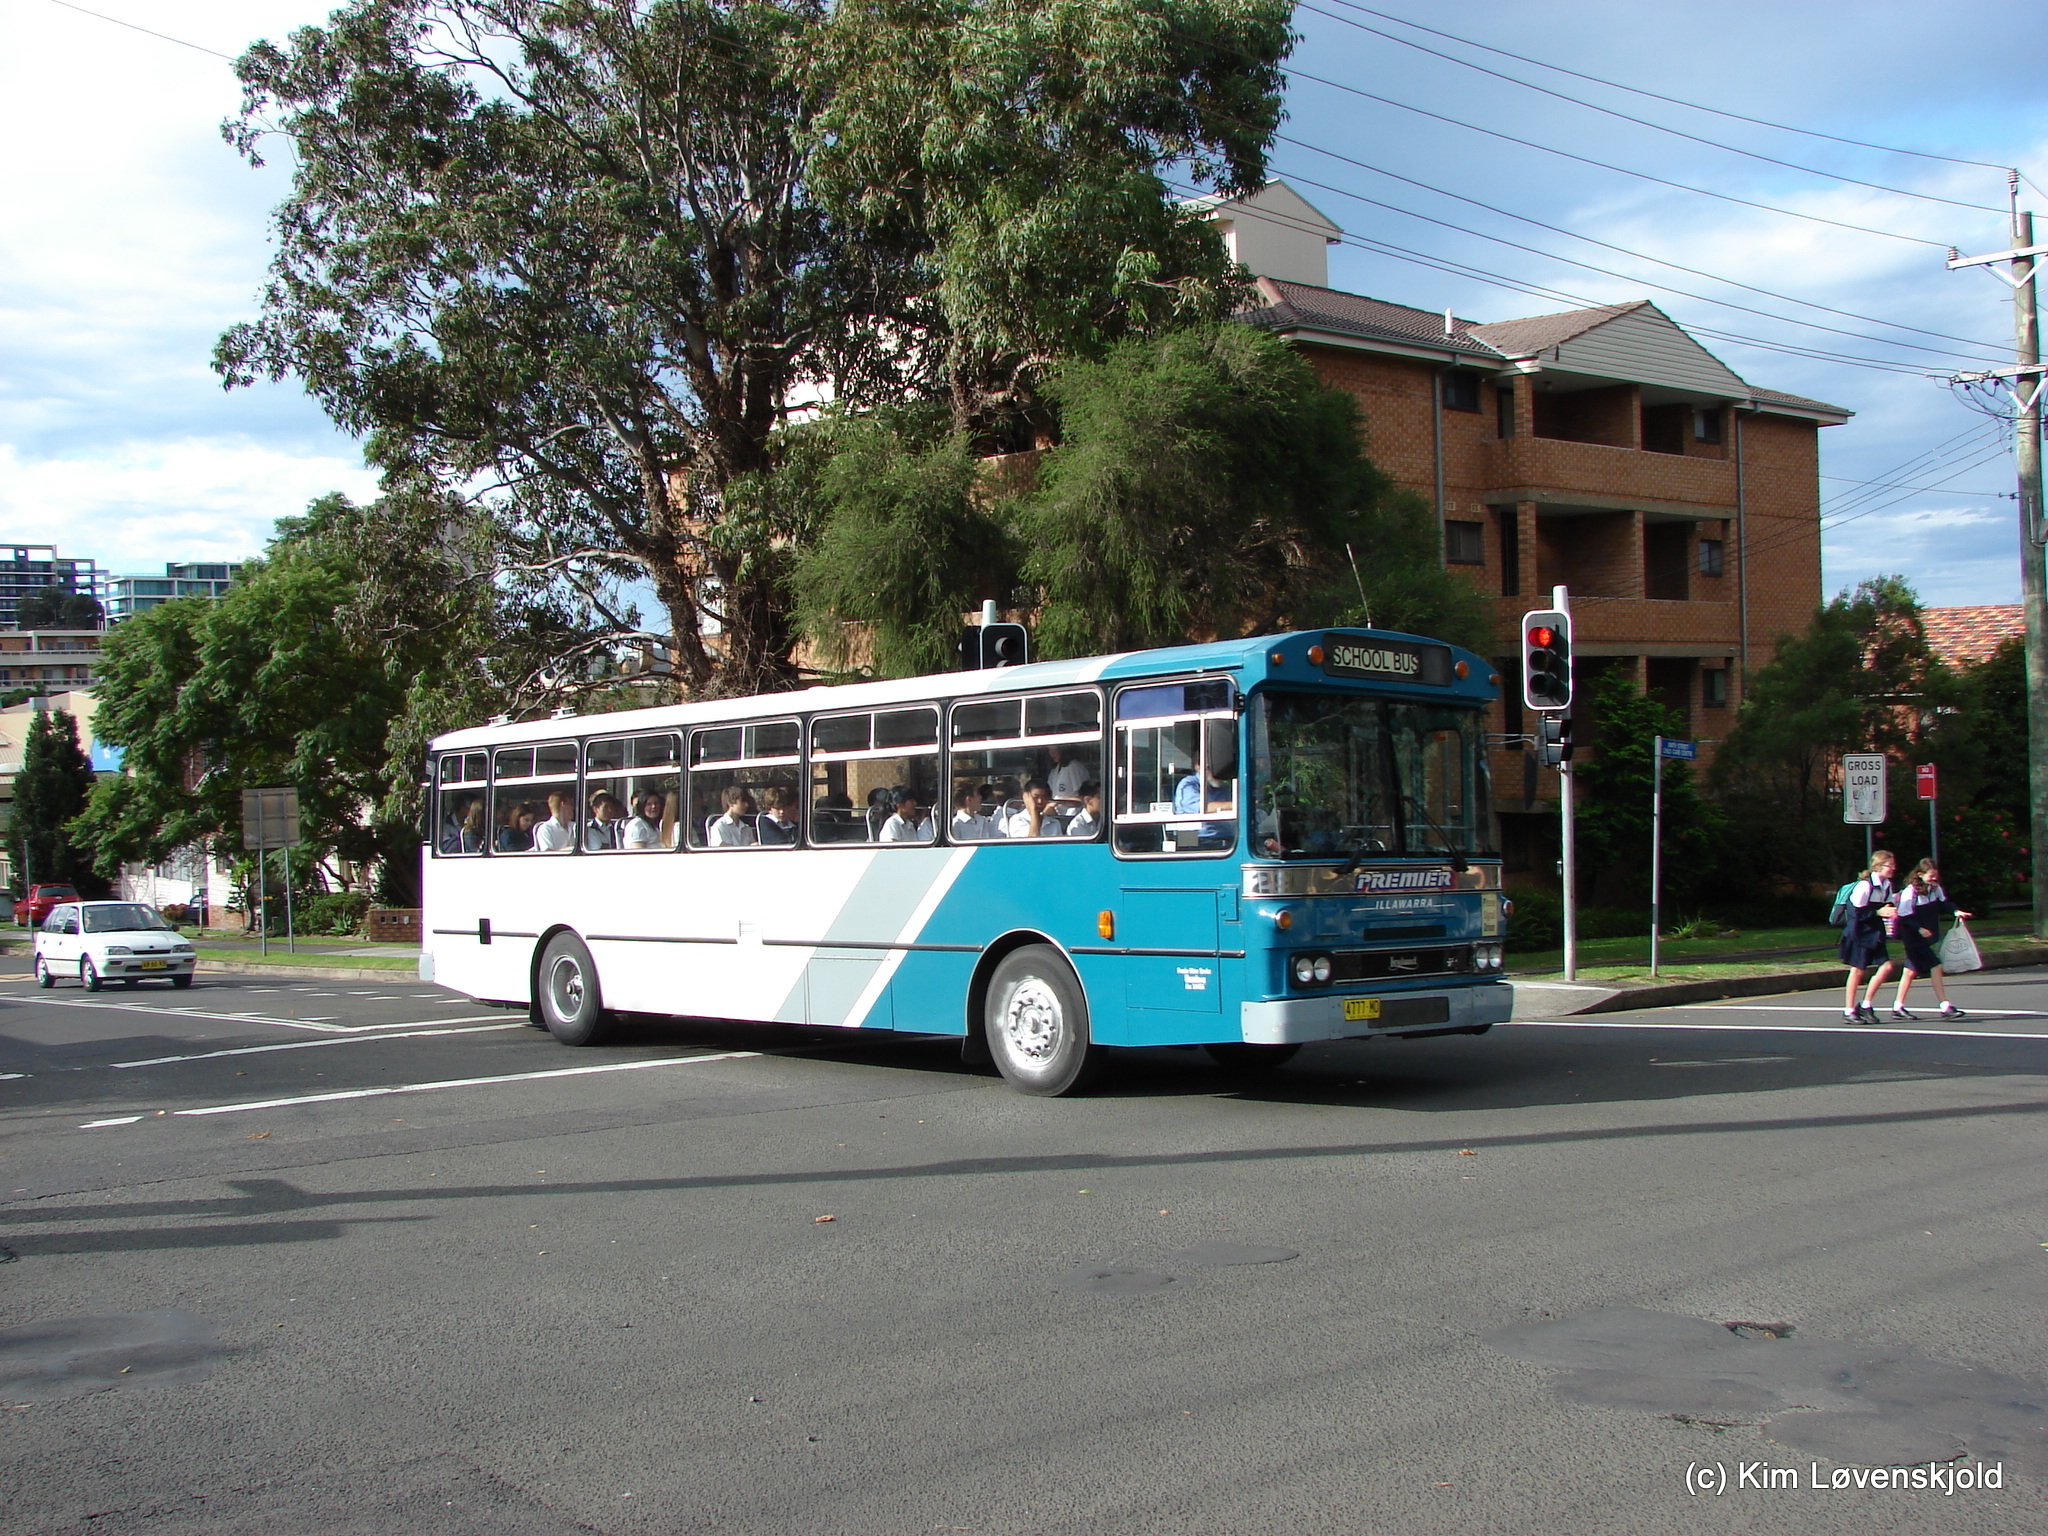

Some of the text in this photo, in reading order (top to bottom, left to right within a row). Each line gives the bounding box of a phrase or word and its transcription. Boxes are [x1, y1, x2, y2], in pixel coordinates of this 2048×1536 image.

[1332, 646, 1418, 672] SCHOOL BUS
[1848, 761, 1881, 771] GROSS
[1851, 776, 1878, 786] LOAD
[1357, 872, 1452, 889] PREMIER
[1375, 899, 1433, 910] ILLAWARRA
